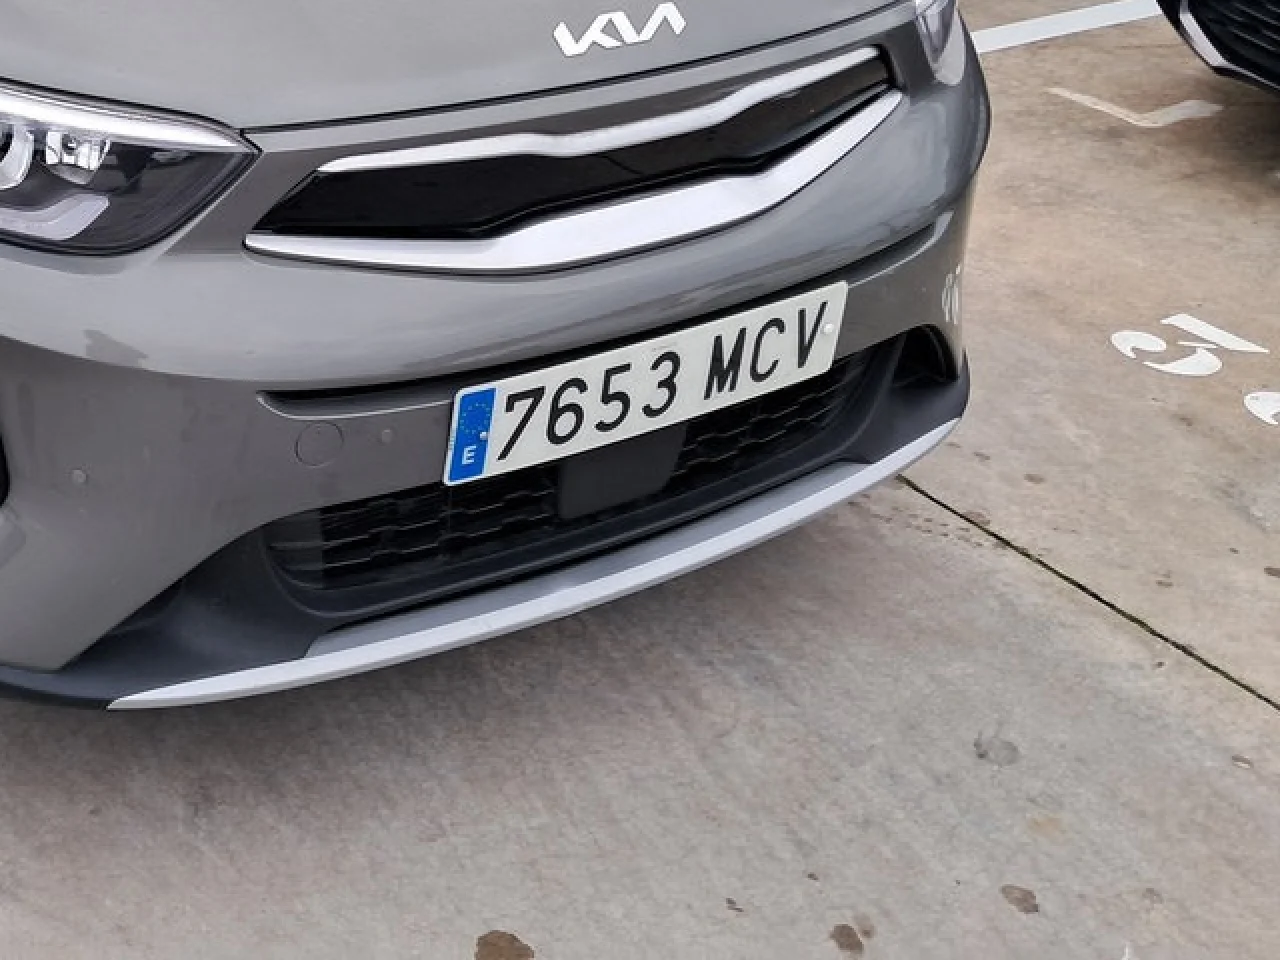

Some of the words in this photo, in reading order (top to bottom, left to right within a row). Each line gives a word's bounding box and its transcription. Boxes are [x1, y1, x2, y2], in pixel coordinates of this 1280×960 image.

[553, 1, 687, 57] KIA
[497, 351, 681, 461] 7653
[703, 301, 829, 401] MCV
[461, 445, 476, 466] E
